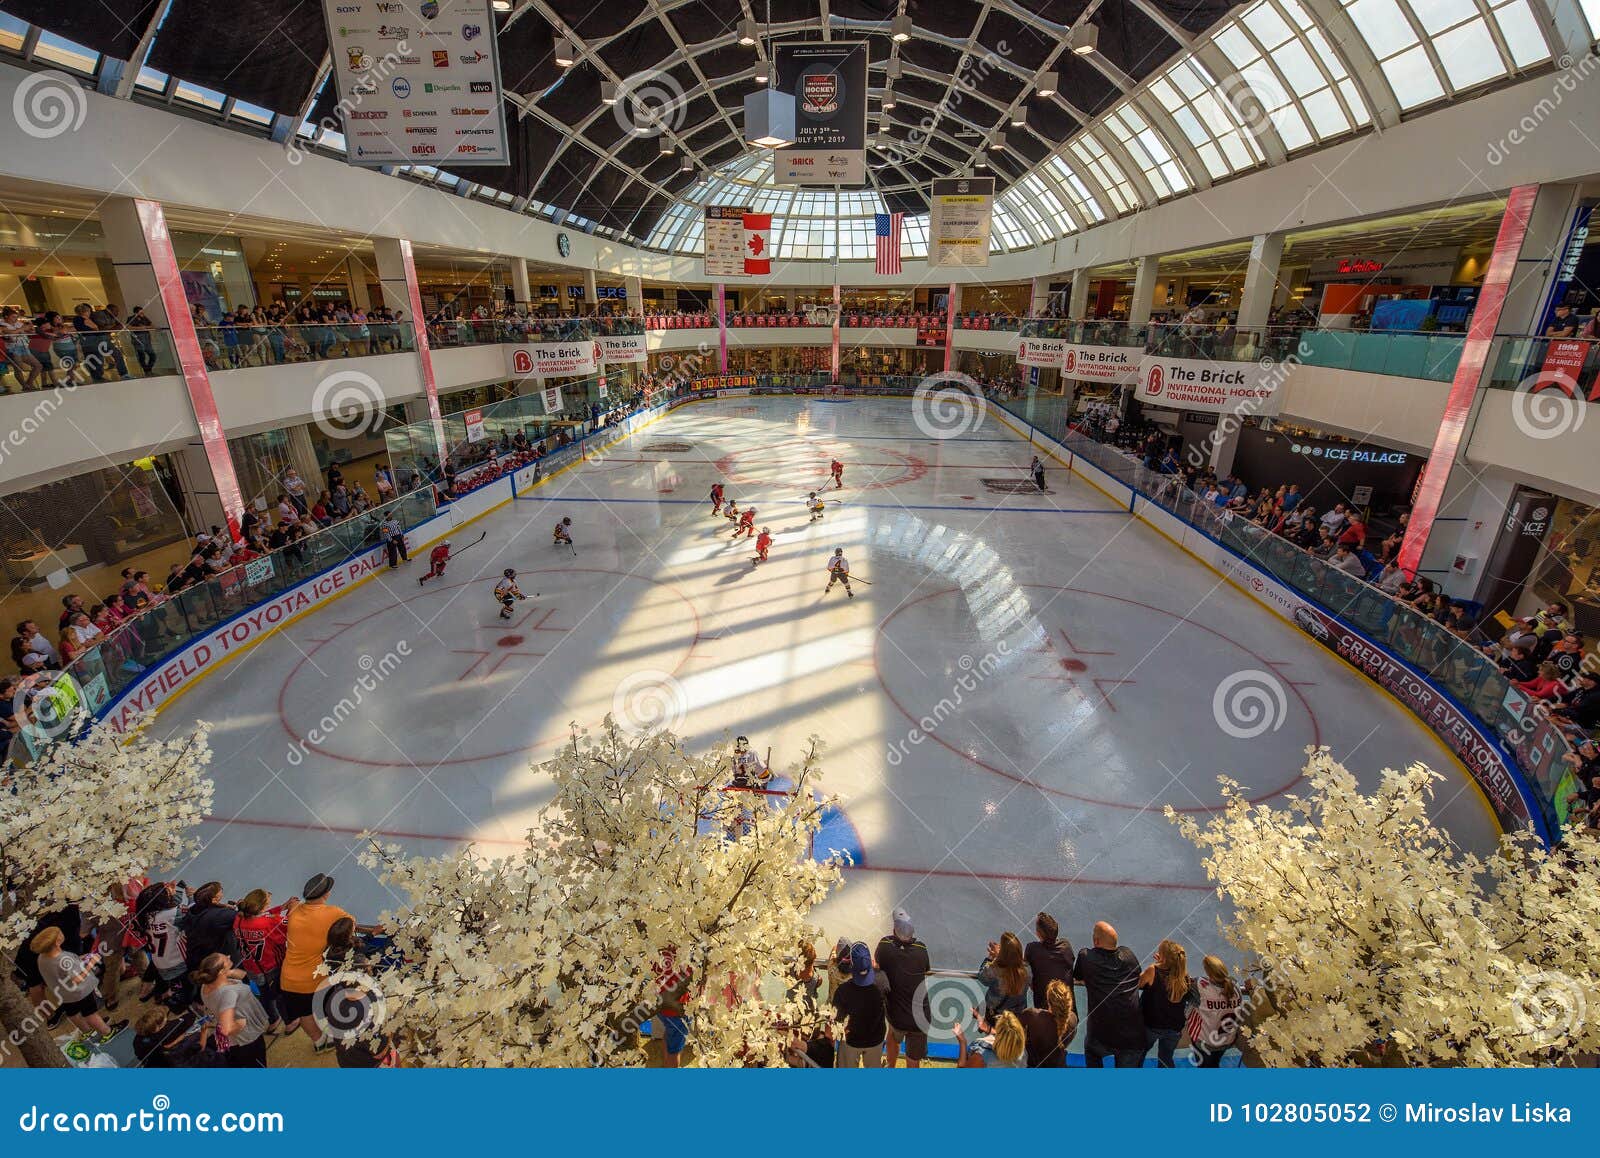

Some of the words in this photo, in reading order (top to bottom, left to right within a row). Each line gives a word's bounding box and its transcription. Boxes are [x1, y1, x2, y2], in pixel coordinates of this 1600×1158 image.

[800, 127, 818, 135] JULY
[412, 145, 436, 153] BRICK
[1559, 226, 1589, 281] KERNELS
[1337, 259, 1351, 272] Tim
[622, 340, 638, 348] Brick
[1042, 343, 1064, 352] Brick
[536, 350, 556, 359] The
[558, 347, 581, 358] Brick
[1079, 351, 1096, 361] The
[1098, 352, 1128, 363] Brick
[1077, 363, 1116, 371] INVITATIONAL
[1556, 359, 1582, 367] ANGELES
[1077, 369, 1116, 378] TOURNAMENT
[1171, 366, 1196, 380] The
[1200, 369, 1246, 385] Brick
[1167, 383, 1227, 396] INVITATIONAL
[1229, 388, 1272, 398] HOCKEY
[1166, 391, 1228, 405] TOURNAMENT
[1324, 448, 1349, 460] ICE
[1352, 450, 1408, 464] PALACE
[1523, 522, 1546, 532] ICE
[215, 590, 311, 651] TOYOTA
[313, 571, 345, 600] ICE
[349, 536, 409, 581] PALAE
[1265, 587, 1292, 609] TOYOTA
[1340, 634, 1400, 678] CREDIT
[1399, 674, 1433, 706] FOR
[1432, 702, 1513, 802] EVERYONE!!!
